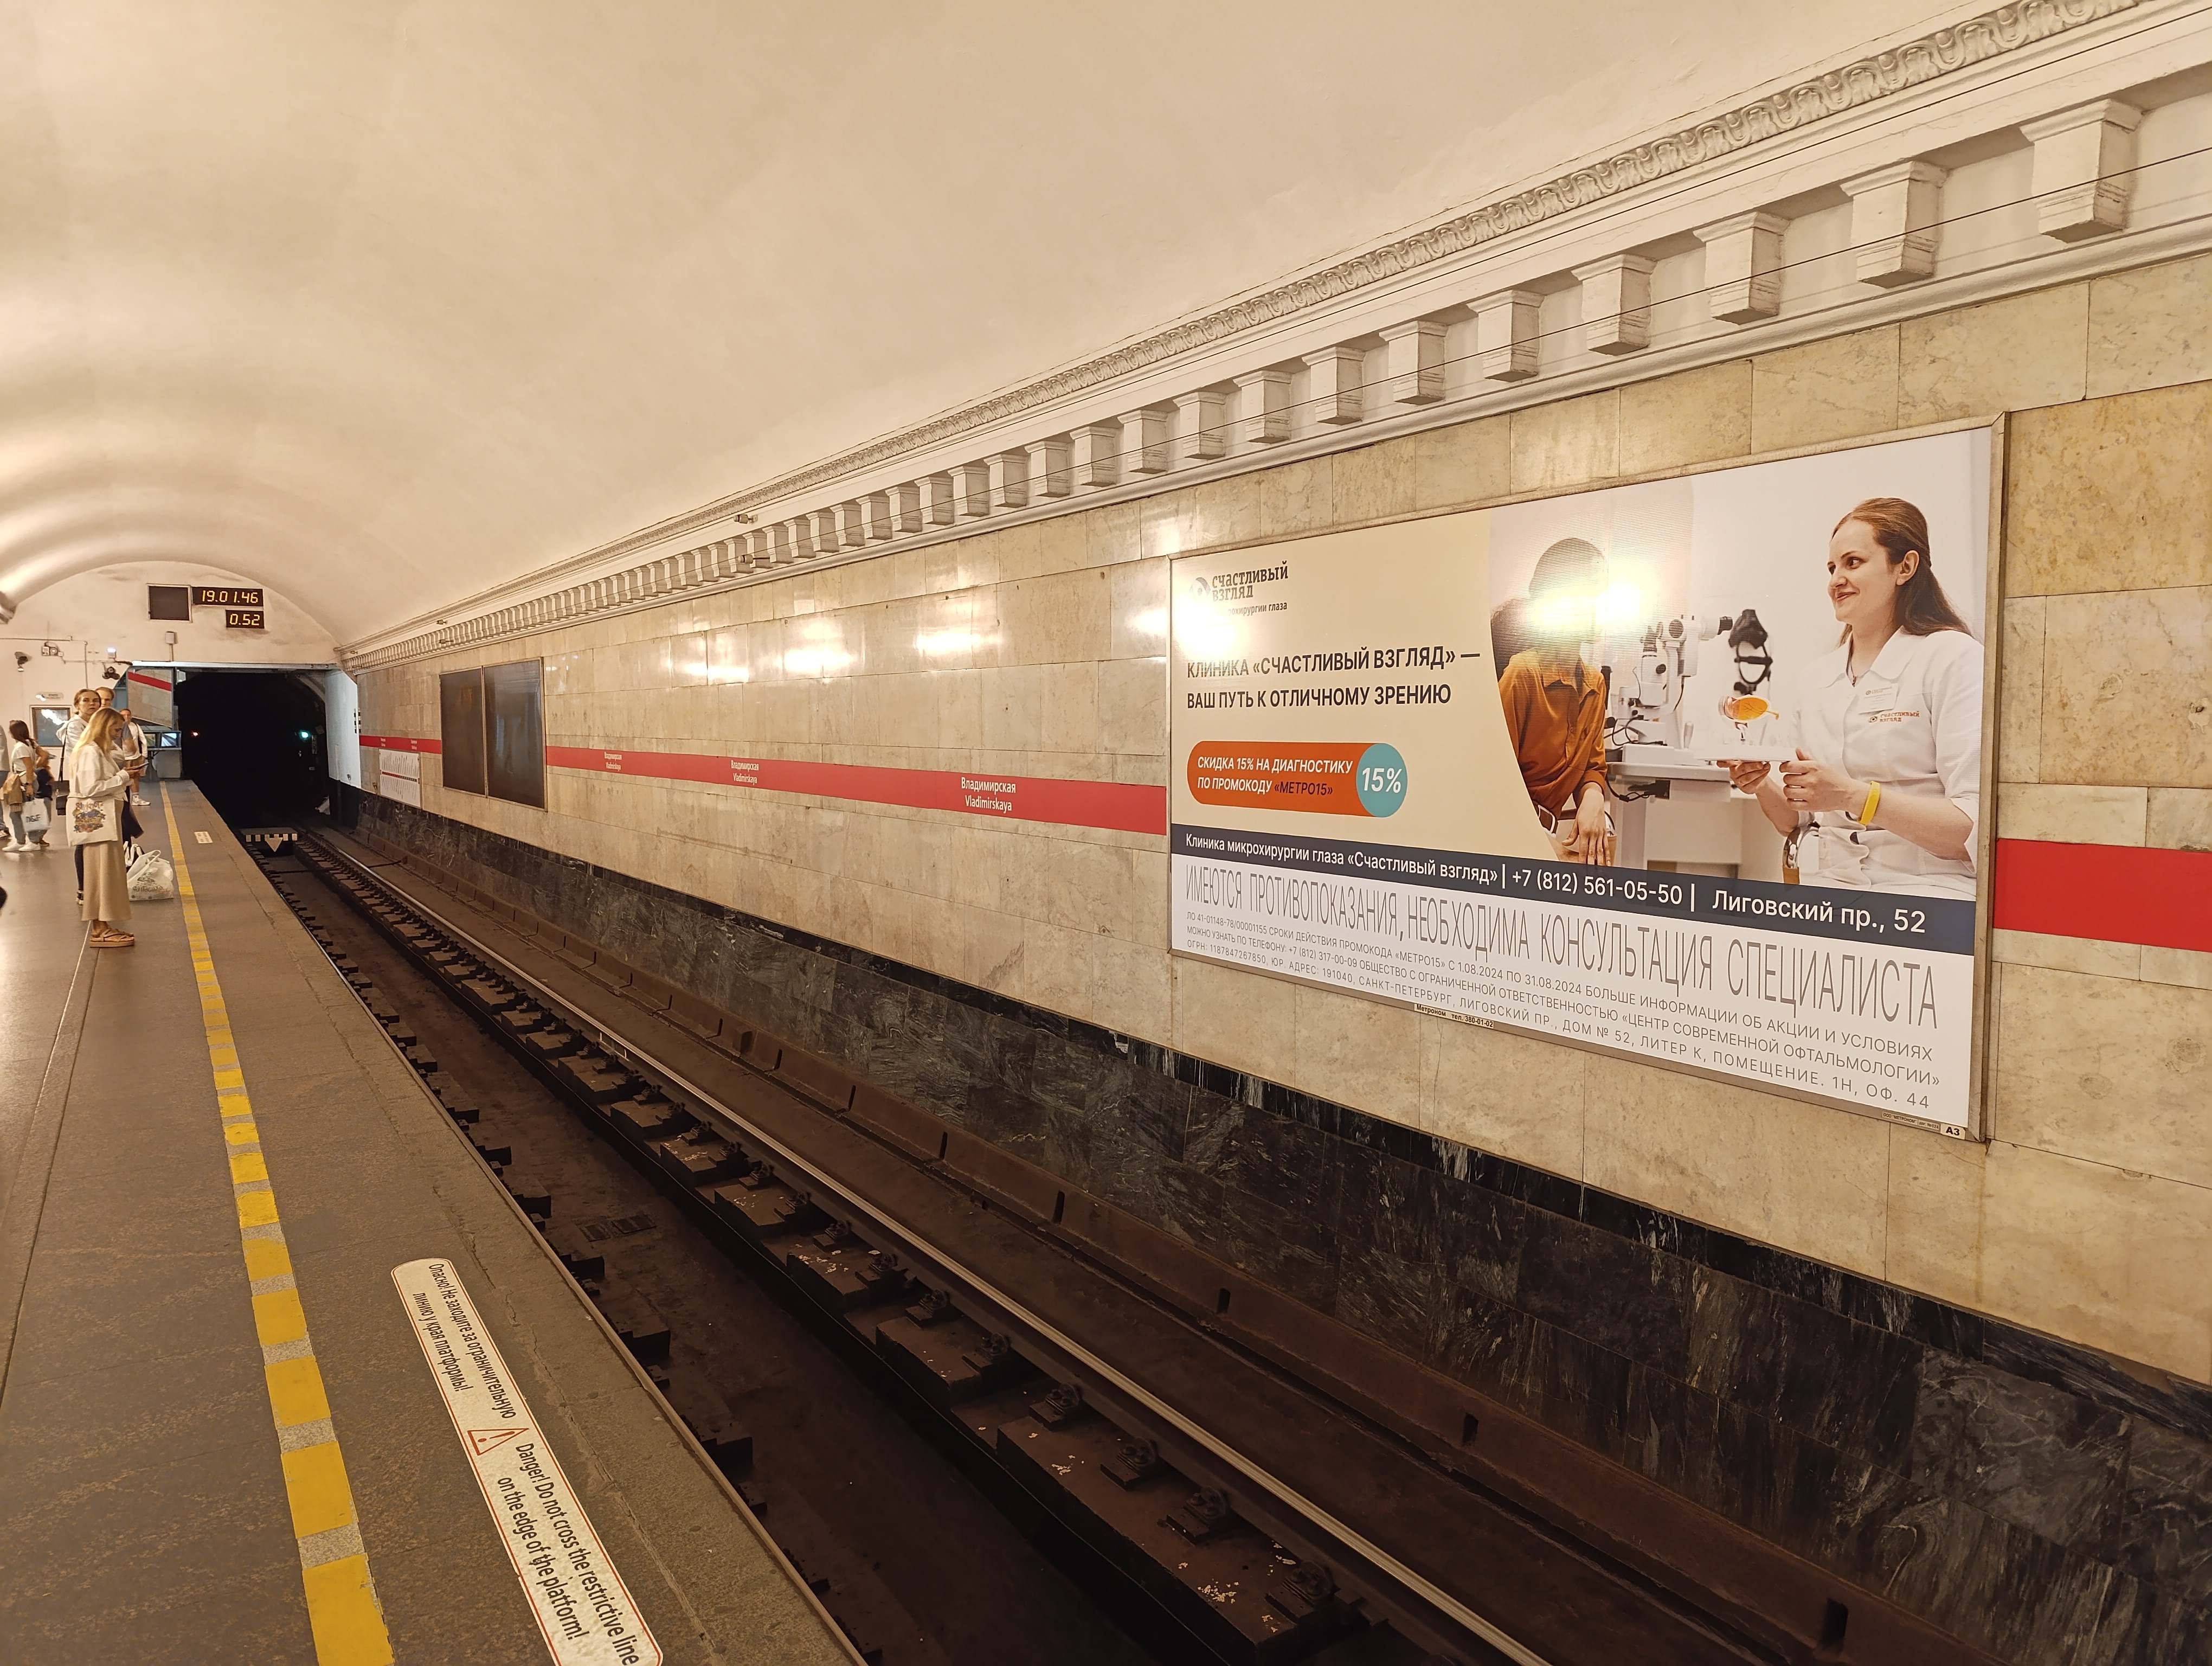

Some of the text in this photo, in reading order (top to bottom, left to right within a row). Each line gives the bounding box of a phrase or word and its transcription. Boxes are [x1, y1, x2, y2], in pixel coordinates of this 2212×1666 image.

[202, 590, 258, 604] 19.01.46
[1268, 602, 1287, 611] глаза
[229, 613, 260, 626] 0.52
[1187, 658, 1249, 678] КЛИНИКА
[1252, 645, 1370, 675] «СЧАСТЛИВЫЙ
[1373, 645, 1456, 671] ВЗГЛЯД»
[1187, 683, 1452, 709] ВАШ ПУТЬ К ОТЛИЧНОМУ ЗРЕНИЮ
[1197, 755, 1354, 774] СКИДКА 15% НА ДИАГНОСТИКУ
[961, 777, 1016, 795] Владимирская
[1197, 776, 1333, 796] ПО ПРОМОКОДУ «МЕТРО15»
[1361, 767, 1403, 794] 15%
[965, 795, 1012, 813] Vladimirskaya
[1185, 832, 1926, 934] Клиника микрохирургии глаза «Счастливый взгляд» +7 (812) 561-05-50 Лиговский пр., 52
[1186, 863, 1938, 1030] ИМЕЮТСЯ ПРОТИВОПОКАЗАНИЯ, НЕОБХОДИМА КОНСУЛЬТАЦИЯ СПЕЦИАЛИСТА
[1186, 925, 1211, 938] МОЖНО
[1211, 930, 1236, 944] УЗНАТЬ
[1236, 934, 1248, 946] ПО
[1288, 945, 1297, 956] +7
[1298, 946, 1317, 961] (812)
[1318, 951, 1358, 969] 317-00-09
[1359, 959, 1407, 979] ОБЩЕСТВО
[1418, 971, 1496, 997] ОГРАНИЧЕННОЙ
[1498, 987, 1618, 1022] ОТВЕТСТВЕННОСТЬЮ
[1622, 1012, 1669, 1031] «ЦЕНТР
[1673, 1021, 1779, 1055] СОВРЕМЕННОЙ
[1783, 1043, 1940, 1086] ОФТАЛЬМОЛОГИИ»
[1268, 926, 1294, 940] СРОКИ
[1295, 931, 1338, 949] ДЕЙСТВИЯ
[1339, 939, 1393, 960] ПРОМОКОДА
[1394, 950, 1446, 968] «МЕТРО15»
[1457, 961, 1504, 981] 1.08.2024
[1506, 970, 1522, 984] ПО
[1524, 973, 1583, 996] 31.08.2024
[1585, 984, 1636, 1005] БОЛЬШЕ
[1639, 994, 1738, 1025] ИНФОРМАЦИИ
[1742, 1014, 1763, 1029] ОБ
[1766, 1018, 1819, 1041] АКЦИИ
[1825, 1028, 1836, 1043] И
[1841, 1031, 1933, 1062] УСЛОВИЯХ
[1416, 1005, 1493, 1028] Метроном тел. 380-01-02
[1459, 997, 1529, 1023] ЛИГОВСКИЙ
[1562, 1018, 1592, 1036] ДОМ
[1615, 1029, 1635, 1048] 52,
[1639, 1035, 1687, 1056] ЛИТЕР
[1713, 1050, 1824, 1087] ПОМЕЩЕНИЕ.
[1831, 1076, 1858, 1097] 1Н,
[1866, 1083, 1898, 1103] ОФ.
[1906, 1092, 1930, 1110] 44
[412, 1292, 434, 1316] линию
[422, 1321, 446, 1340] края
[428, 1264, 516, 1419] Опасно! Не заходите за ограничительную
[434, 1340, 474, 1392] платформы!
[497, 1477, 590, 1640] on the edge of the platform!
[515, 1443, 640, 1666] Danger! Do not cross the restrictive line
